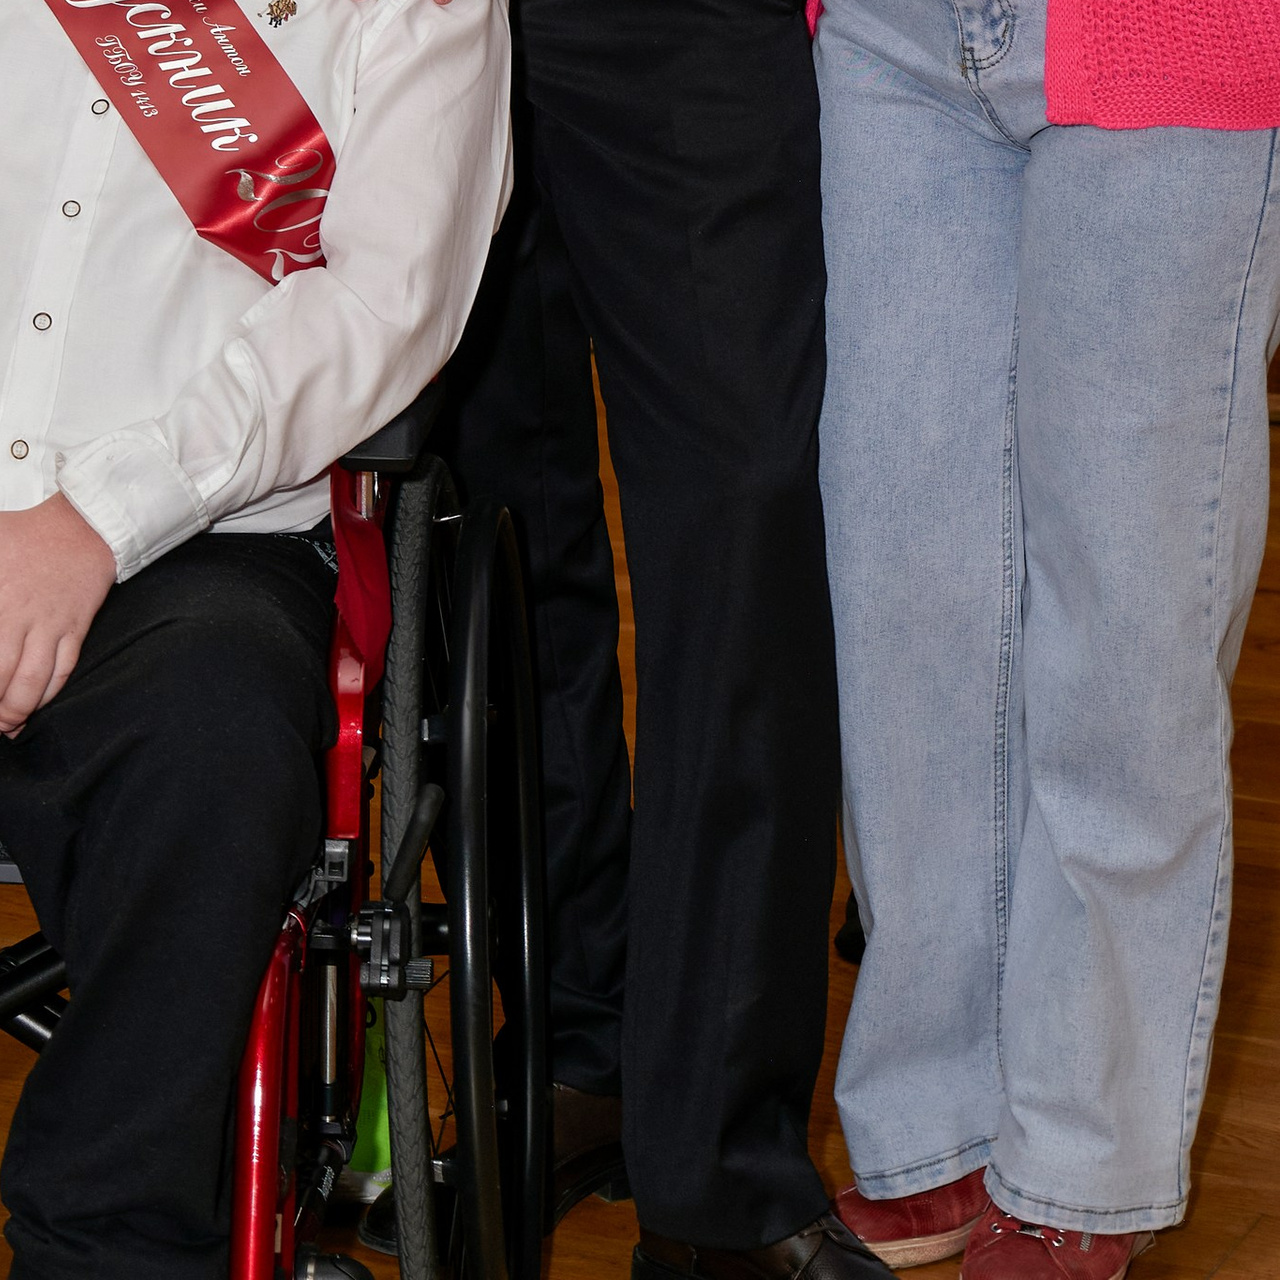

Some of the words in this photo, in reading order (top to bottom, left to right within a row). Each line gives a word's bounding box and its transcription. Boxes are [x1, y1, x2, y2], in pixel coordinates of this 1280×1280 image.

[94, 34, 147, 87] ГБОУ
[130, 89, 159, 118] 1413
[202, 16, 252, 77] Антон
[224, 148, 329, 281] 202
